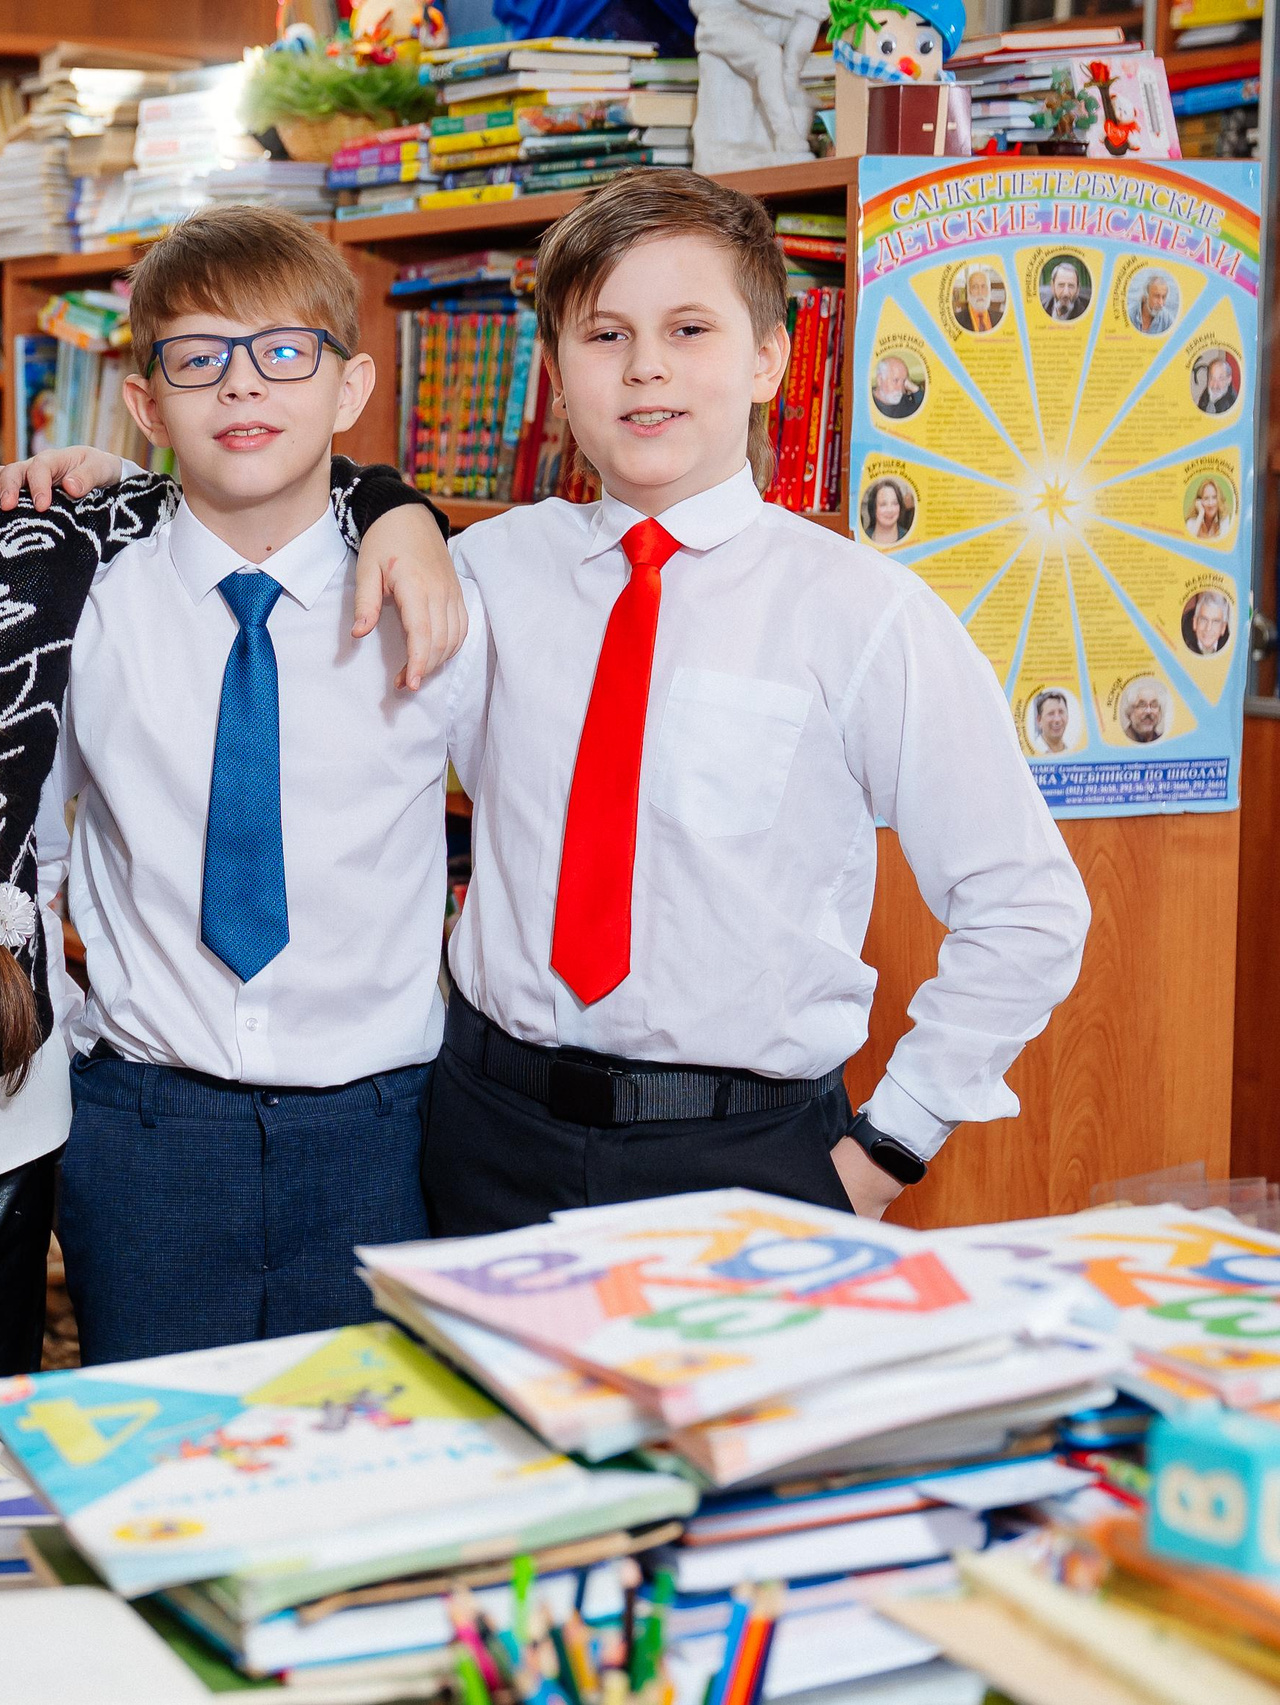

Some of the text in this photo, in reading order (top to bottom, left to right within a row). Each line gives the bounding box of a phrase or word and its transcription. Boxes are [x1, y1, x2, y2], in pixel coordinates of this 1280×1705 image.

[889, 169, 1227, 234] САНКТ-ПЕТЕРБУРГСКИЕ
[875, 201, 1244, 279] ДЕТСКИЕ ПИСАТЕЛИ
[878, 333, 925, 348] ШЕВЧЕНКО
[1060, 769, 1141, 785] УЧЕБНИКОВ
[1144, 769, 1163, 782] ПО
[1167, 767, 1227, 780] ШКОЛАМ
